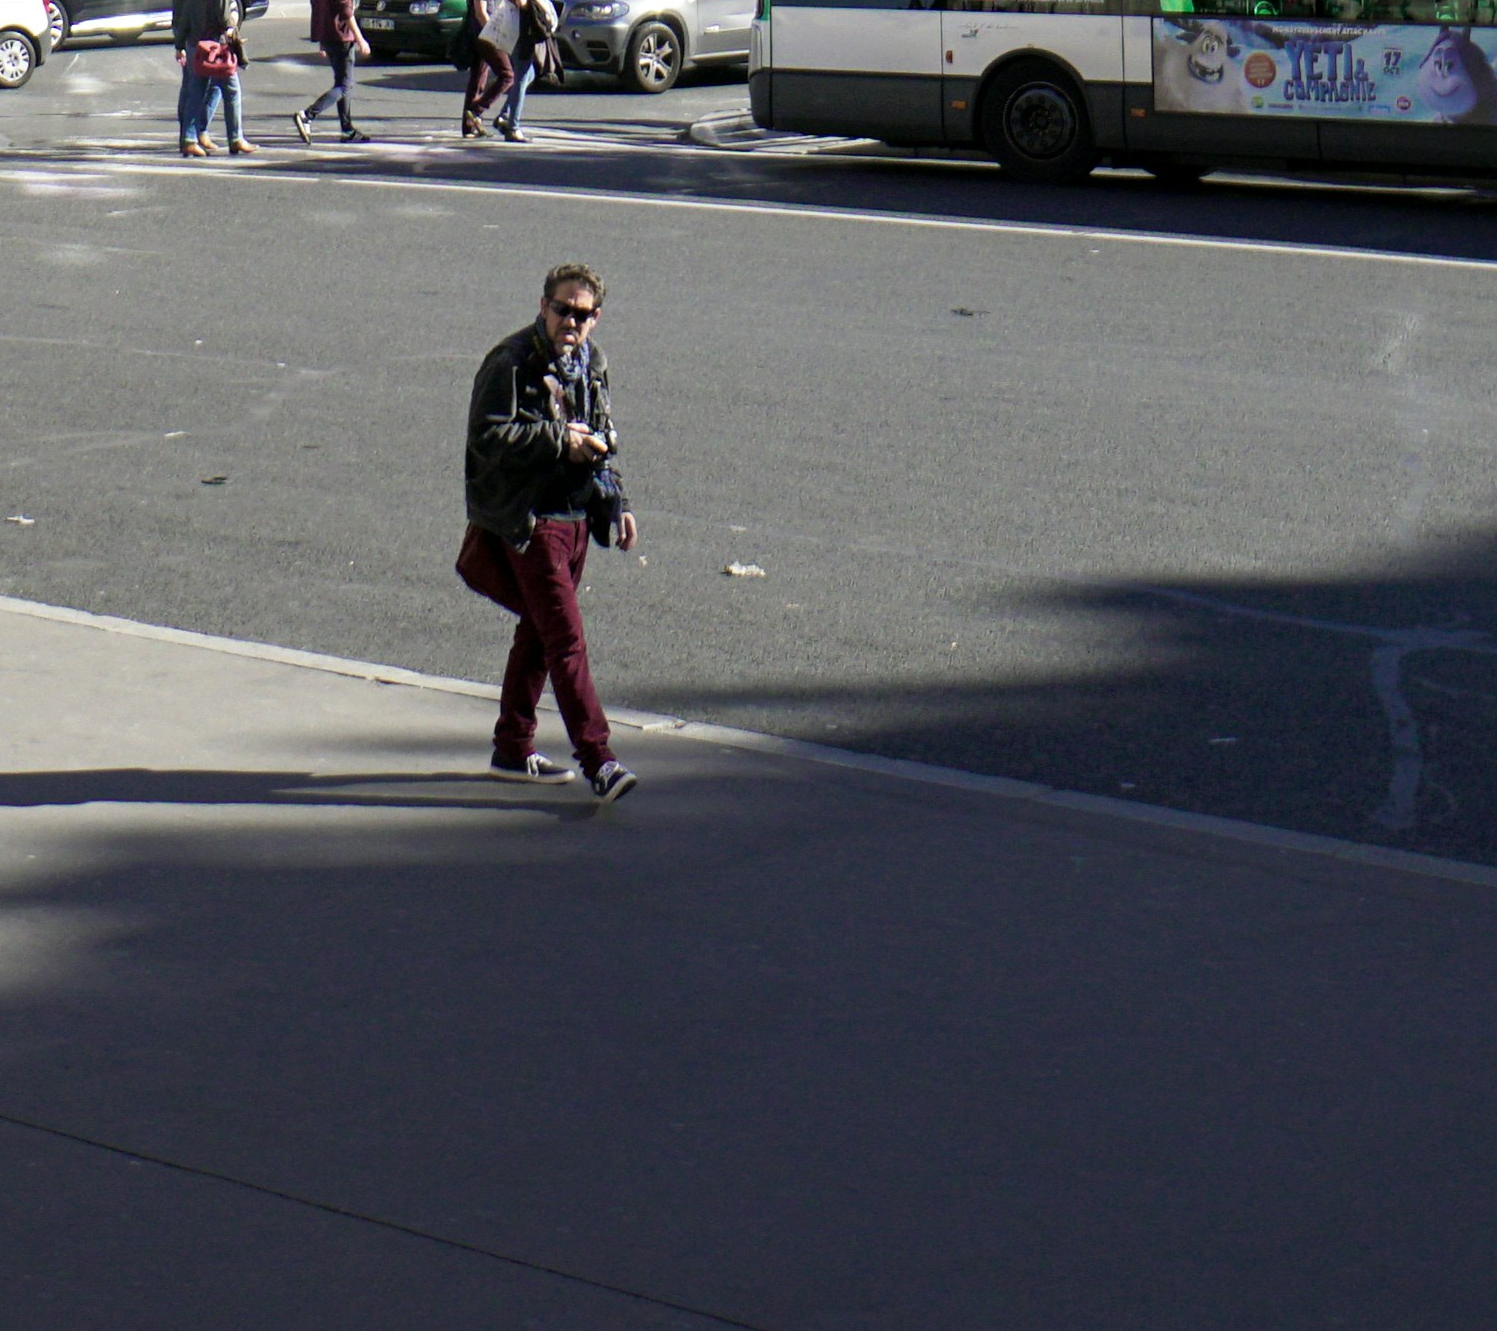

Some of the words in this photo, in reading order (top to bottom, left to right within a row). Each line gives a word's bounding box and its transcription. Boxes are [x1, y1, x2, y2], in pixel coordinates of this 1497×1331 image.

[1284, 40, 1354, 81] YETI
[1354, 58, 1369, 82] &
[1383, 50, 1402, 66] 17
[1283, 78, 1376, 103] COMPAGNIE
